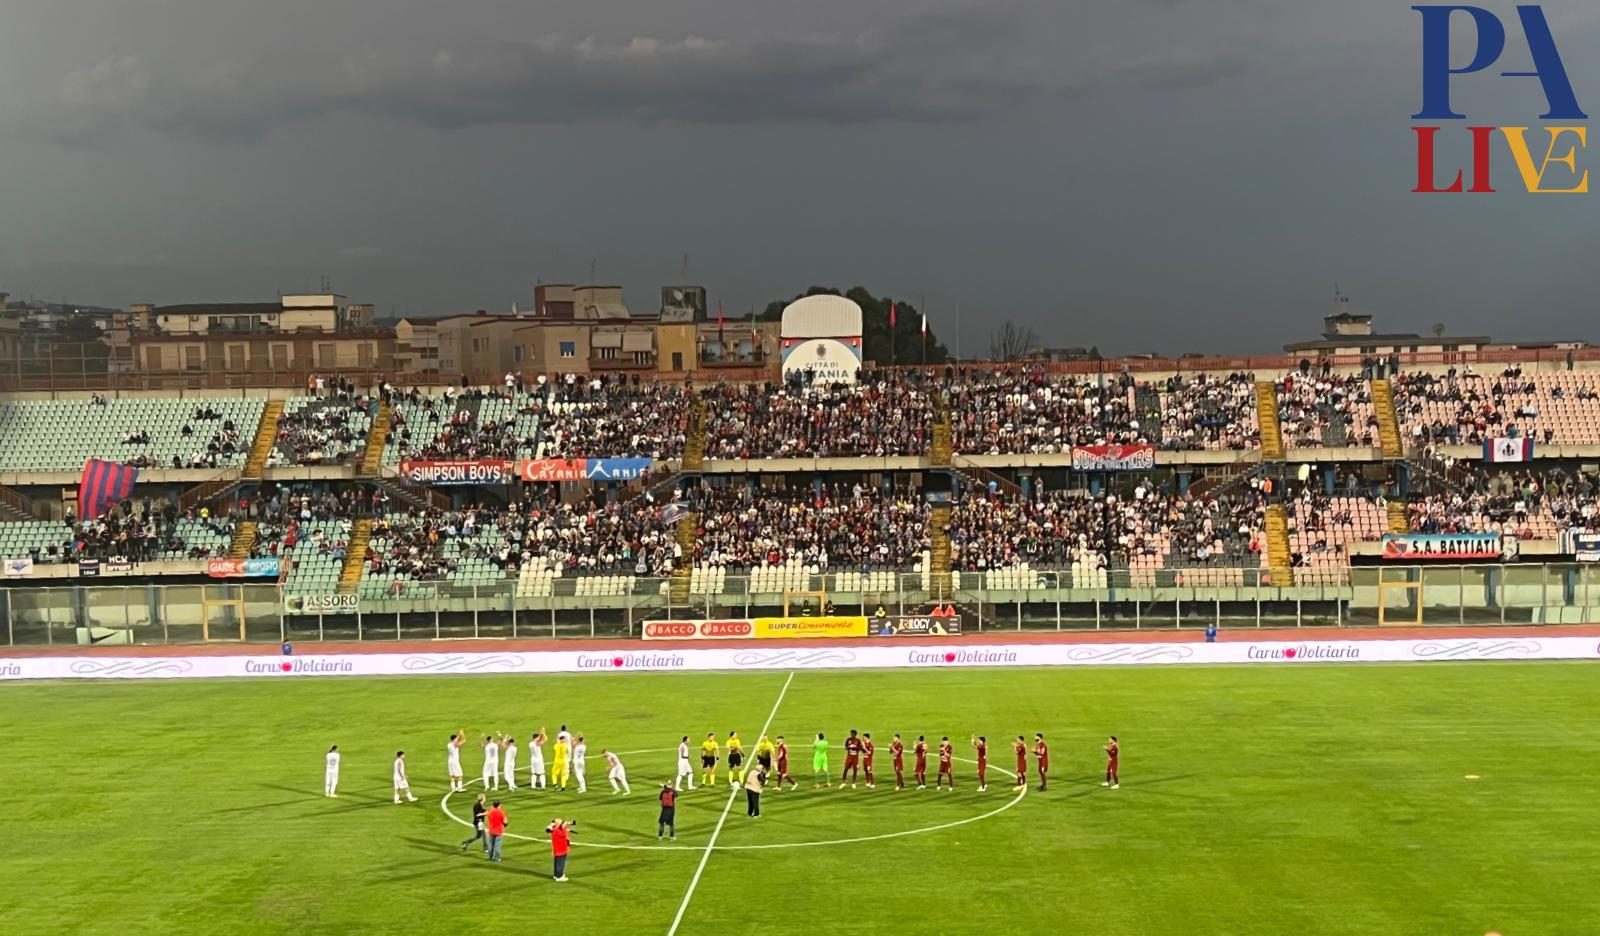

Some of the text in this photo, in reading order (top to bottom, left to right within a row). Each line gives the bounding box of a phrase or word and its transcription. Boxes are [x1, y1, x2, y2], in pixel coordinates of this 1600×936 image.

[414, 465, 501, 481] SIMPSON BOYS
[1412, 539, 1495, 554] S.A. BATTIATI
[307, 594, 358, 606] ASSORO
[657, 625, 694, 634] BACCO
[712, 624, 749, 633] BACCO
[956, 649, 1017, 662] Dolciaria
[1297, 645, 1360, 658] Dolciaria
[292, 659, 353, 672] Dolciaria
[624, 654, 684, 667] Dolciaria
[0, 662, 21, 675] ria
